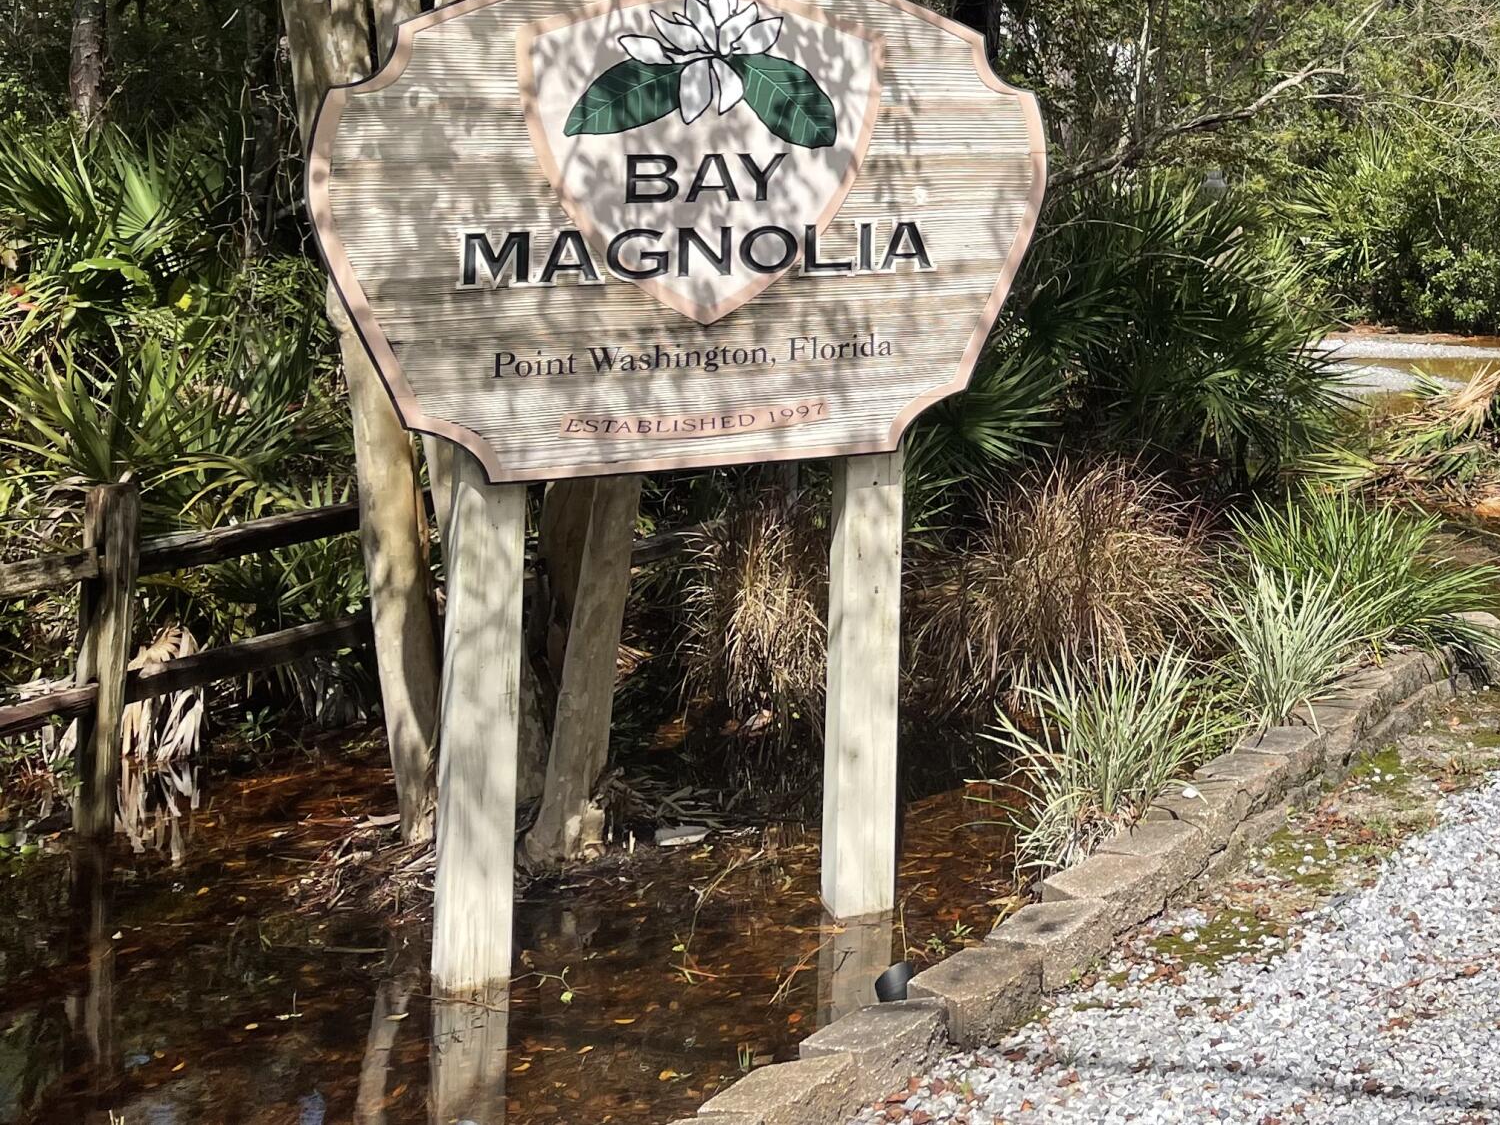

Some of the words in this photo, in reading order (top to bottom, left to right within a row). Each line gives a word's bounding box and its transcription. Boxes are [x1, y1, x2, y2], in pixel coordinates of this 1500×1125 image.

[623, 152, 790, 205] BAY
[461, 220, 935, 286] MAGNOLIA
[491, 350, 578, 379] Point
[587, 344, 776, 373] Washington,
[788, 333, 892, 362] Florida
[563, 413, 756, 435] ESTABLISHED
[768, 402, 826, 424] 1997
